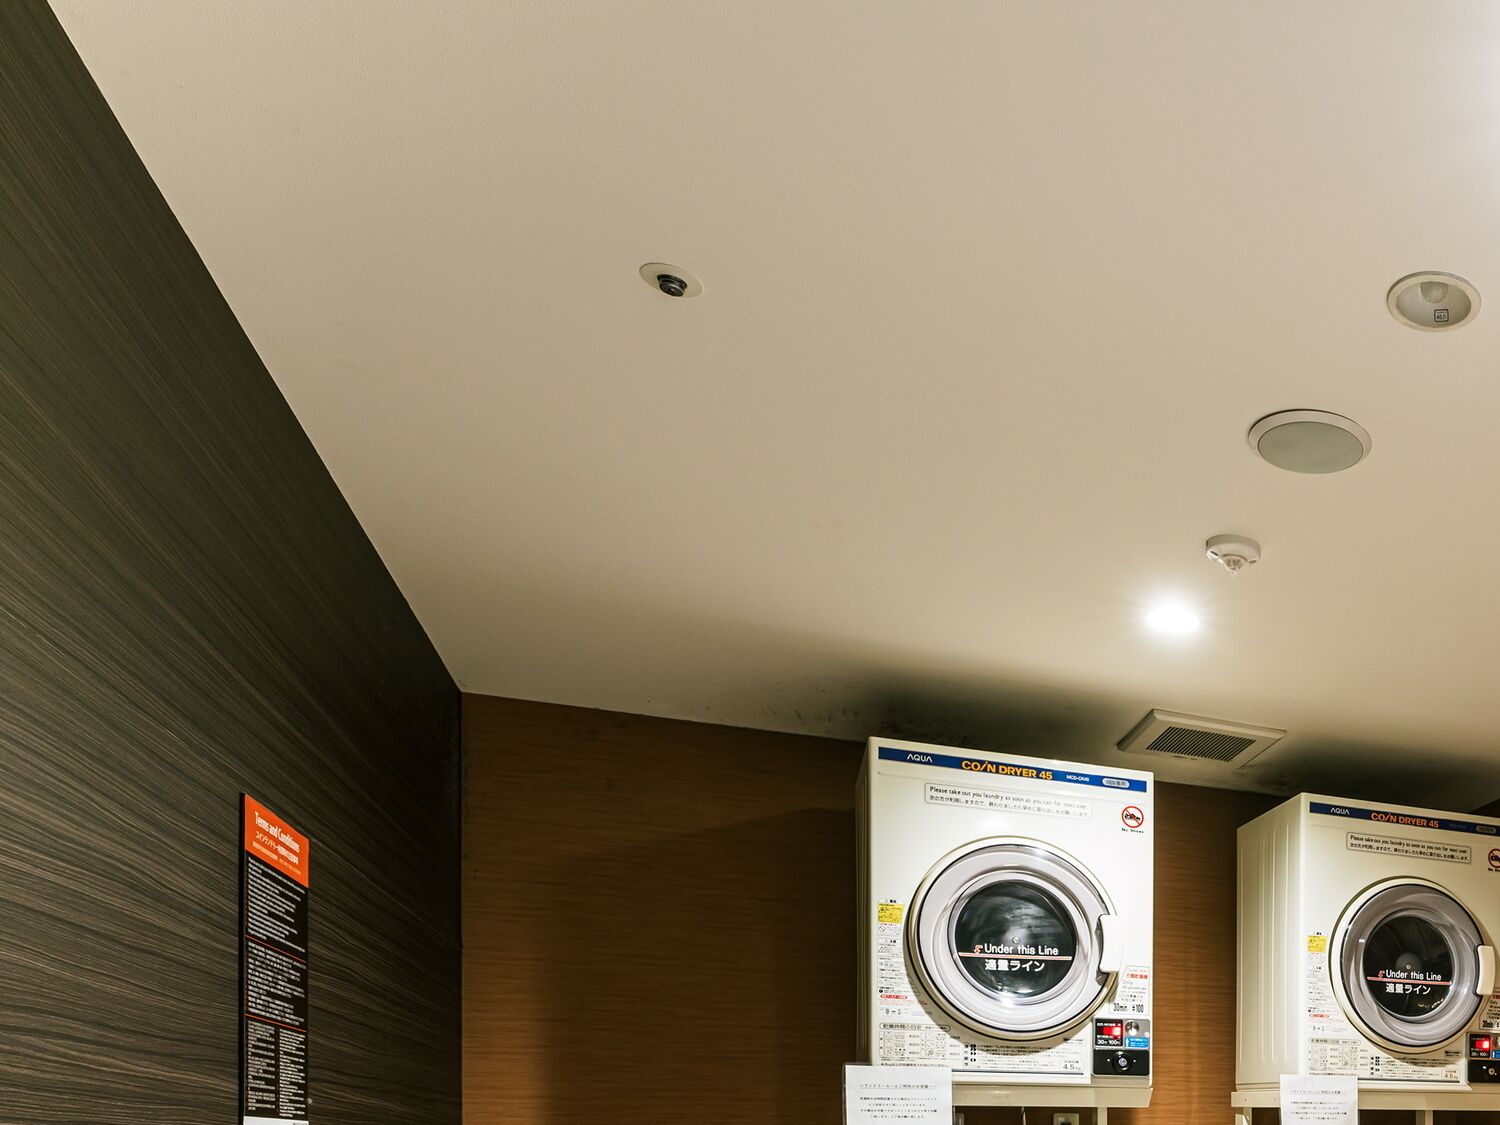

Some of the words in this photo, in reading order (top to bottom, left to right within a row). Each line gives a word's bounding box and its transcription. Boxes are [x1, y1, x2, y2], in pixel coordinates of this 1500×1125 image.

[906, 753, 933, 764] AQUA
[961, 760, 996, 773] COIN
[998, 765, 1037, 778] DRYER
[1039, 770, 1053, 781] 45
[929, 786, 948, 795] Please
[1330, 807, 1350, 816] AQUA
[1371, 811, 1397, 823] COIN
[1398, 816, 1427, 828] DRYER
[1428, 820, 1440, 829] 45
[984, 942, 1014, 955] Under
[1017, 944, 1036, 955] this
[1038, 945, 1059, 956] Line
[984, 959, 1046, 973] 適量ライン
[1385, 969, 1408, 979] Under
[1410, 971, 1424, 981] this
[1426, 972, 1442, 982] Line
[1385, 983, 1431, 995] 適量ライン
